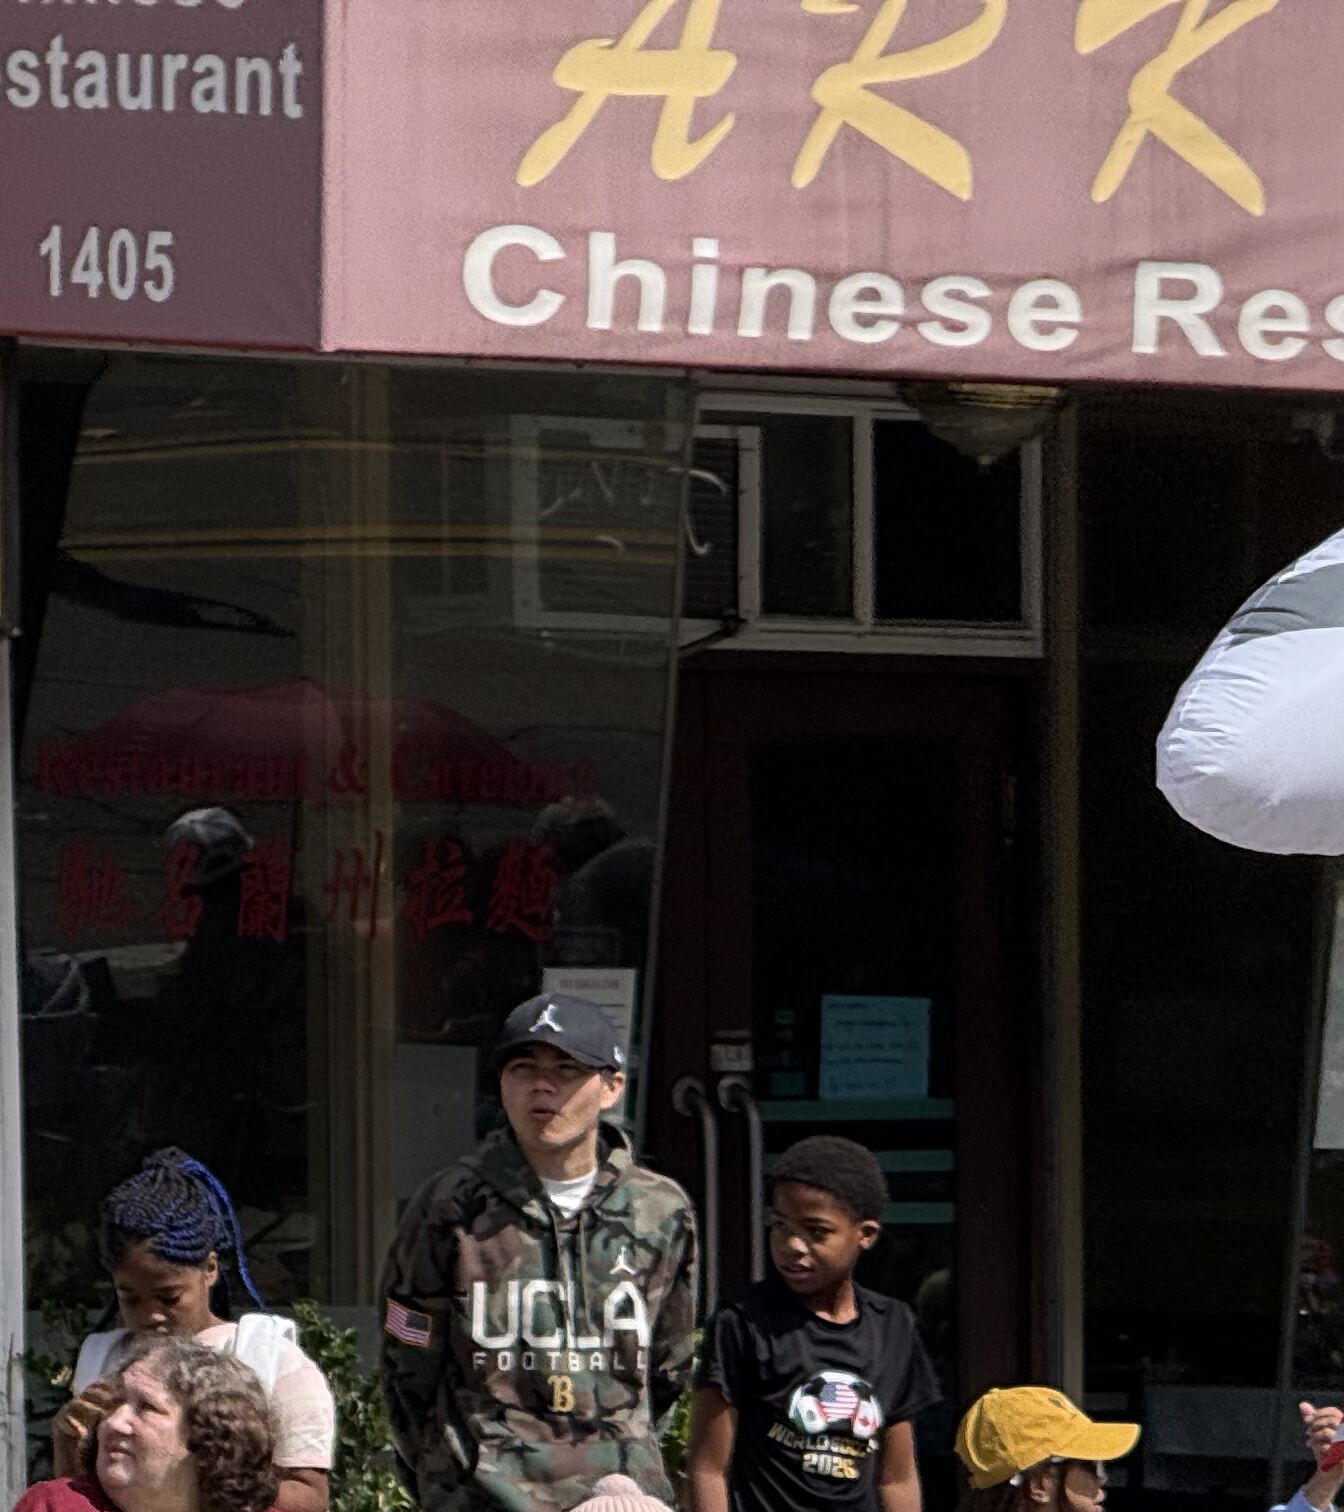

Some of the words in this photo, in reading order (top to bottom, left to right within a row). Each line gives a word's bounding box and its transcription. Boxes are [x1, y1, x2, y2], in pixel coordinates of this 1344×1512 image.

[6, 33, 304, 119] staurant
[39, 224, 175, 302] 1405
[462, 224, 1082, 352] Chinese
[472, 1280, 650, 1349] UCLA
[472, 1351, 648, 1372] FOOTBALL
